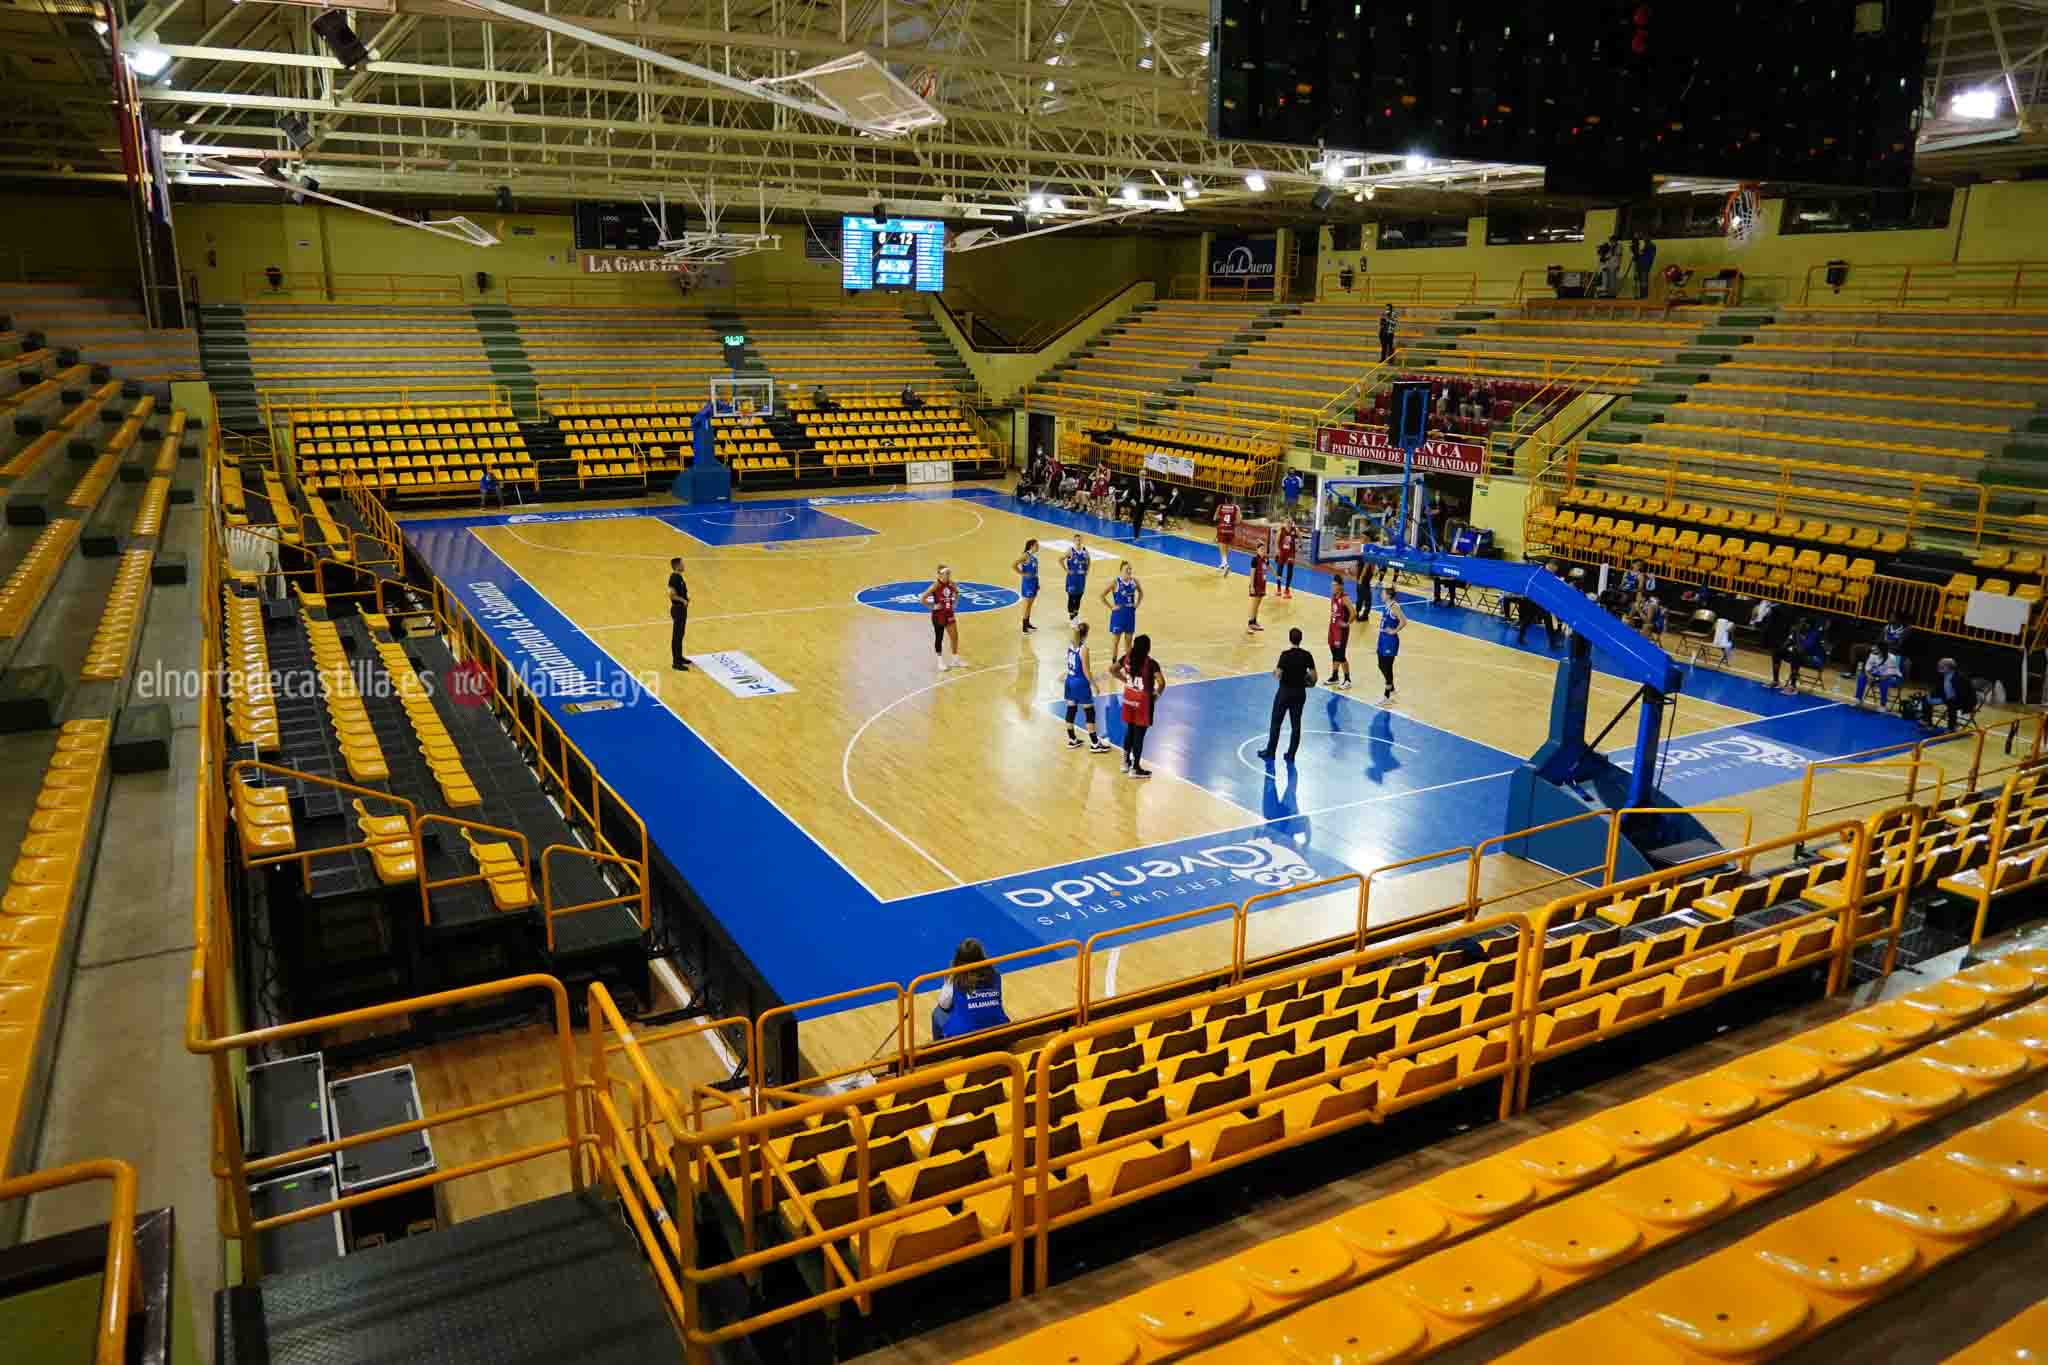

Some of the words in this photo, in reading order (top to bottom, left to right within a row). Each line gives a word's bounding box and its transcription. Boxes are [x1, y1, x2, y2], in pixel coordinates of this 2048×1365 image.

[899, 232, 914, 245] 12
[589, 255, 612, 272] LA
[1227, 246, 1273, 273] Duero
[1332, 443, 1387, 461] PATRIMONIO
[1387, 453, 1401, 464] DE
[1418, 455, 1479, 473] HUMANIDAD
[1348, 431, 1463, 459] SALANCA
[1223, 513, 1231, 524] 4
[1002, 844, 1267, 909] avenida
[1035, 874, 1236, 927] PERFUMERÍAS
